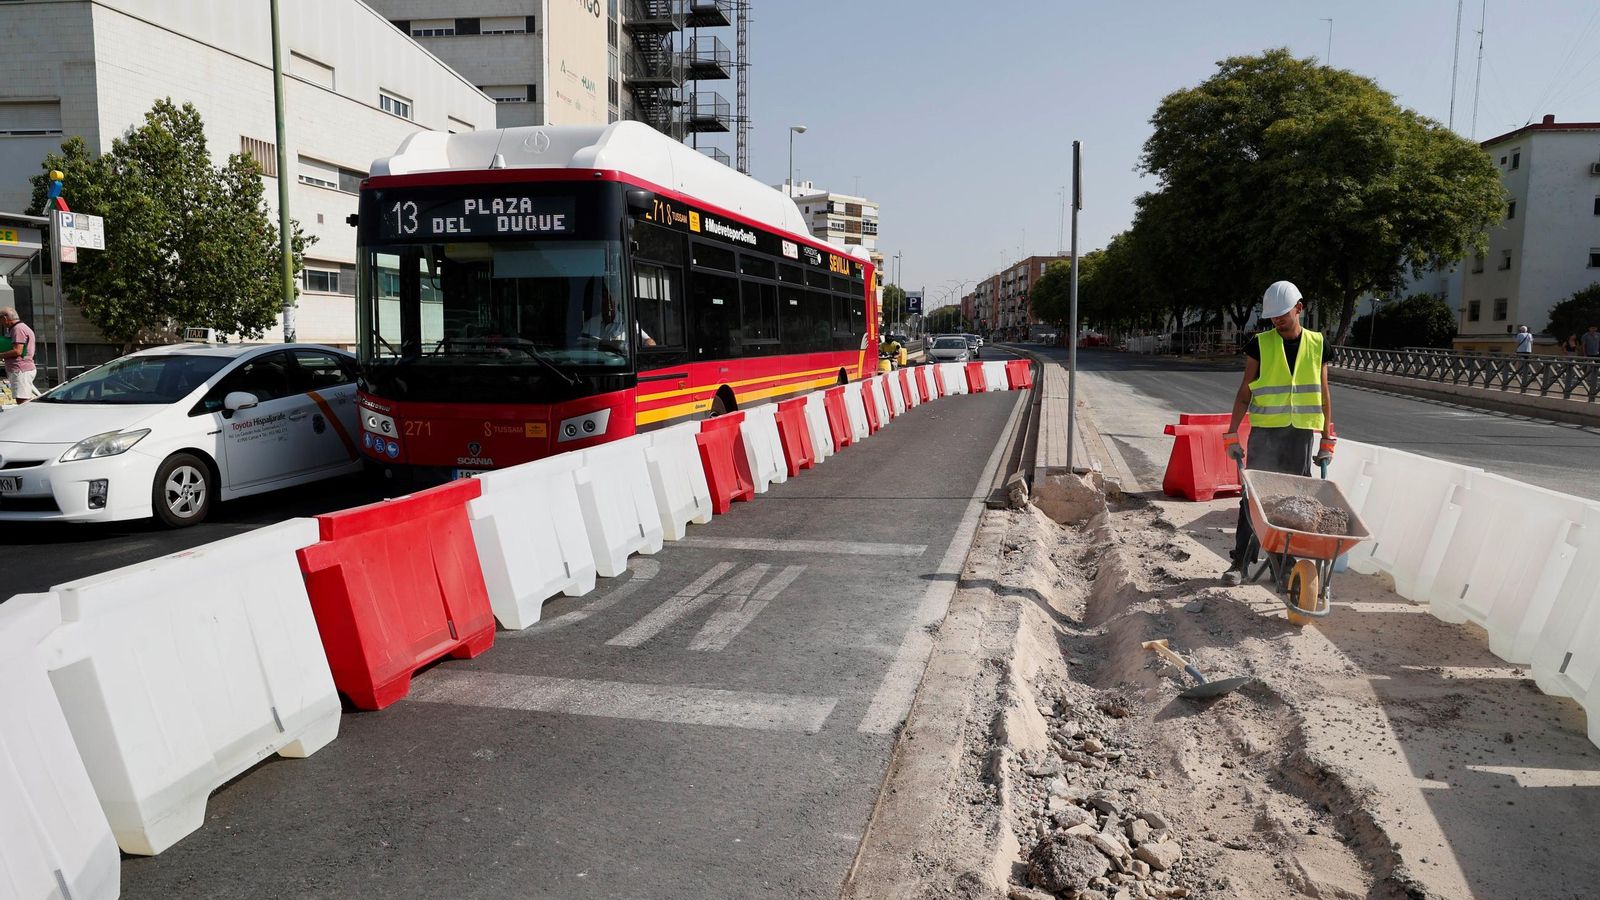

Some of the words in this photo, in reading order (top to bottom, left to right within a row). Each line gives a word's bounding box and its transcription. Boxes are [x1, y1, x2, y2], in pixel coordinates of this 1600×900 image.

[464, 197, 532, 215] PLAZA
[645, 199, 665, 224] 71
[672, 212, 688, 224] TUSSAM
[62, 213, 73, 227] P
[391, 201, 418, 234] 13
[432, 217, 471, 233] DEL
[497, 214, 566, 232] DUQUE
[704, 217, 757, 245] #MuéveteporSevilla
[829, 253, 850, 275] SEVILLA
[909, 297, 918, 307] P
[188, 329, 203, 338] TAXI
[231, 420, 253, 432] Toyota
[404, 420, 431, 437] 271
[456, 457, 494, 465] SCANIA
